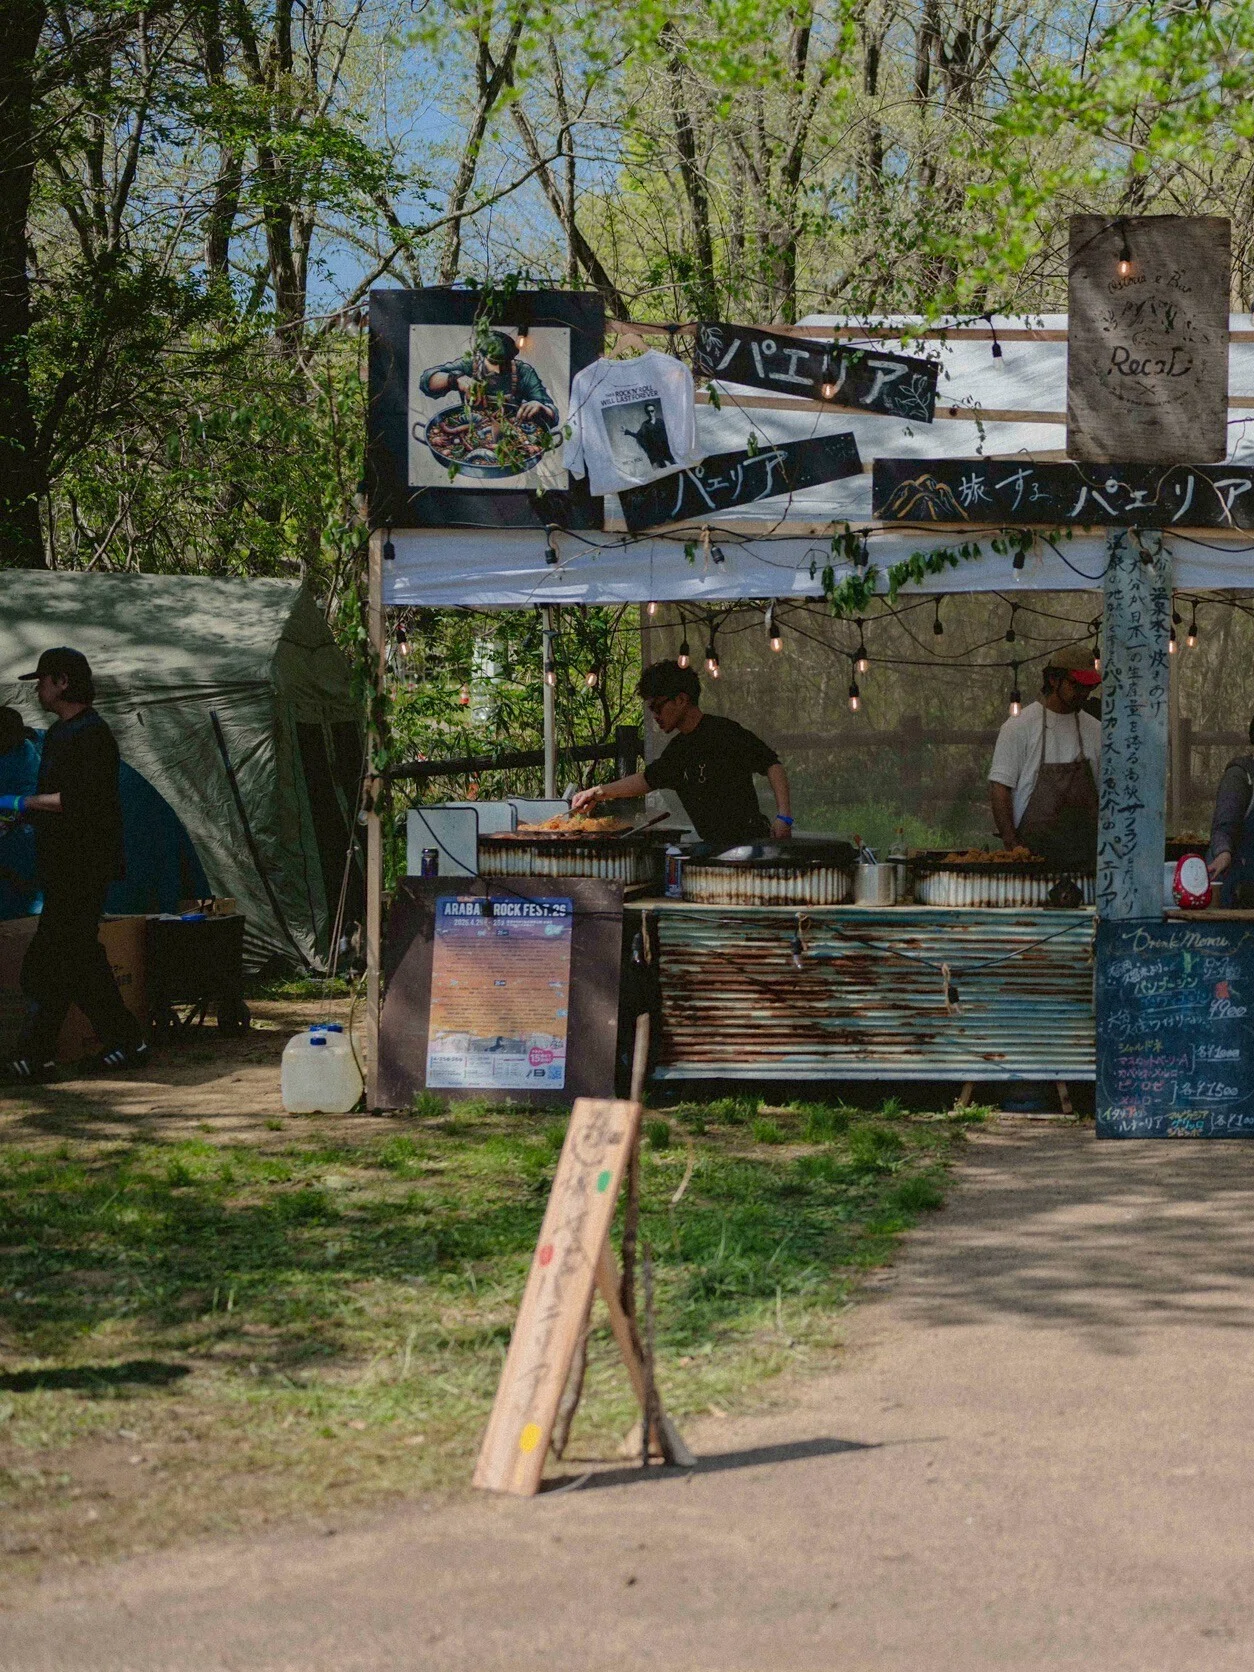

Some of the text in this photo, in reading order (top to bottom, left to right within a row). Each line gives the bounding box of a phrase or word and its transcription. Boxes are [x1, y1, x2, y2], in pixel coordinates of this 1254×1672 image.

[601, 398, 615, 407] WILL
[616, 394, 631, 403] LAST
[632, 389, 659, 401] FOREVER
[444, 903, 486, 916] ARABA
[493, 903, 522, 916] ROCK
